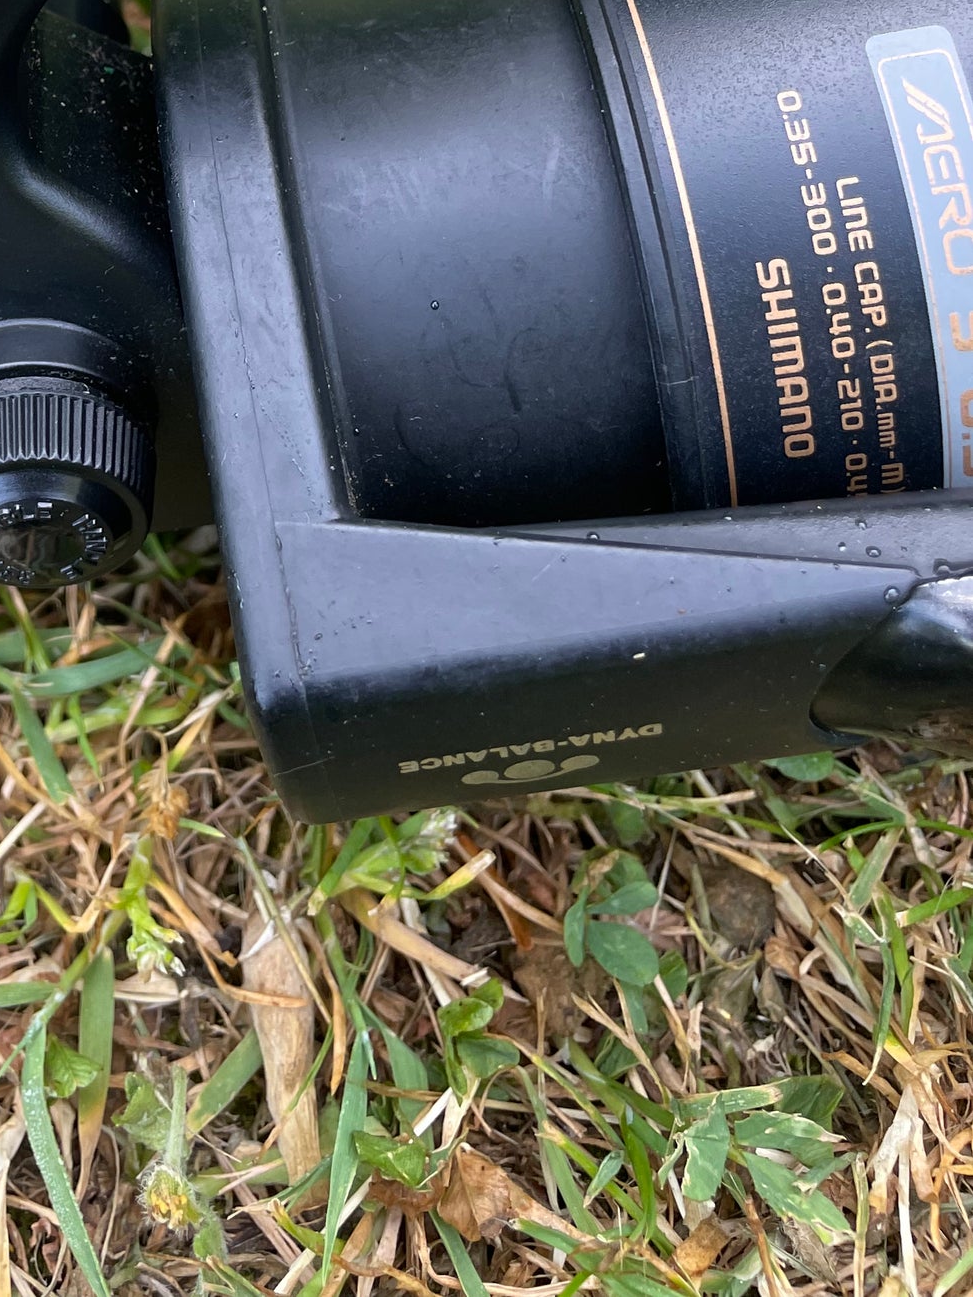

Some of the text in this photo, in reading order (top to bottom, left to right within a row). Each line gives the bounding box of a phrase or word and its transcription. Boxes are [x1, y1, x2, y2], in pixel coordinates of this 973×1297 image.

[836, 176, 874, 252] LINE
[776, 89, 838, 256] 0.35-300
[822, 282, 865, 432] 0.40-210
[854, 260, 888, 334] CAP.
[755, 257, 816, 459] SHIMANO
[397, 722, 664, 774] DYNA-BALANCE
